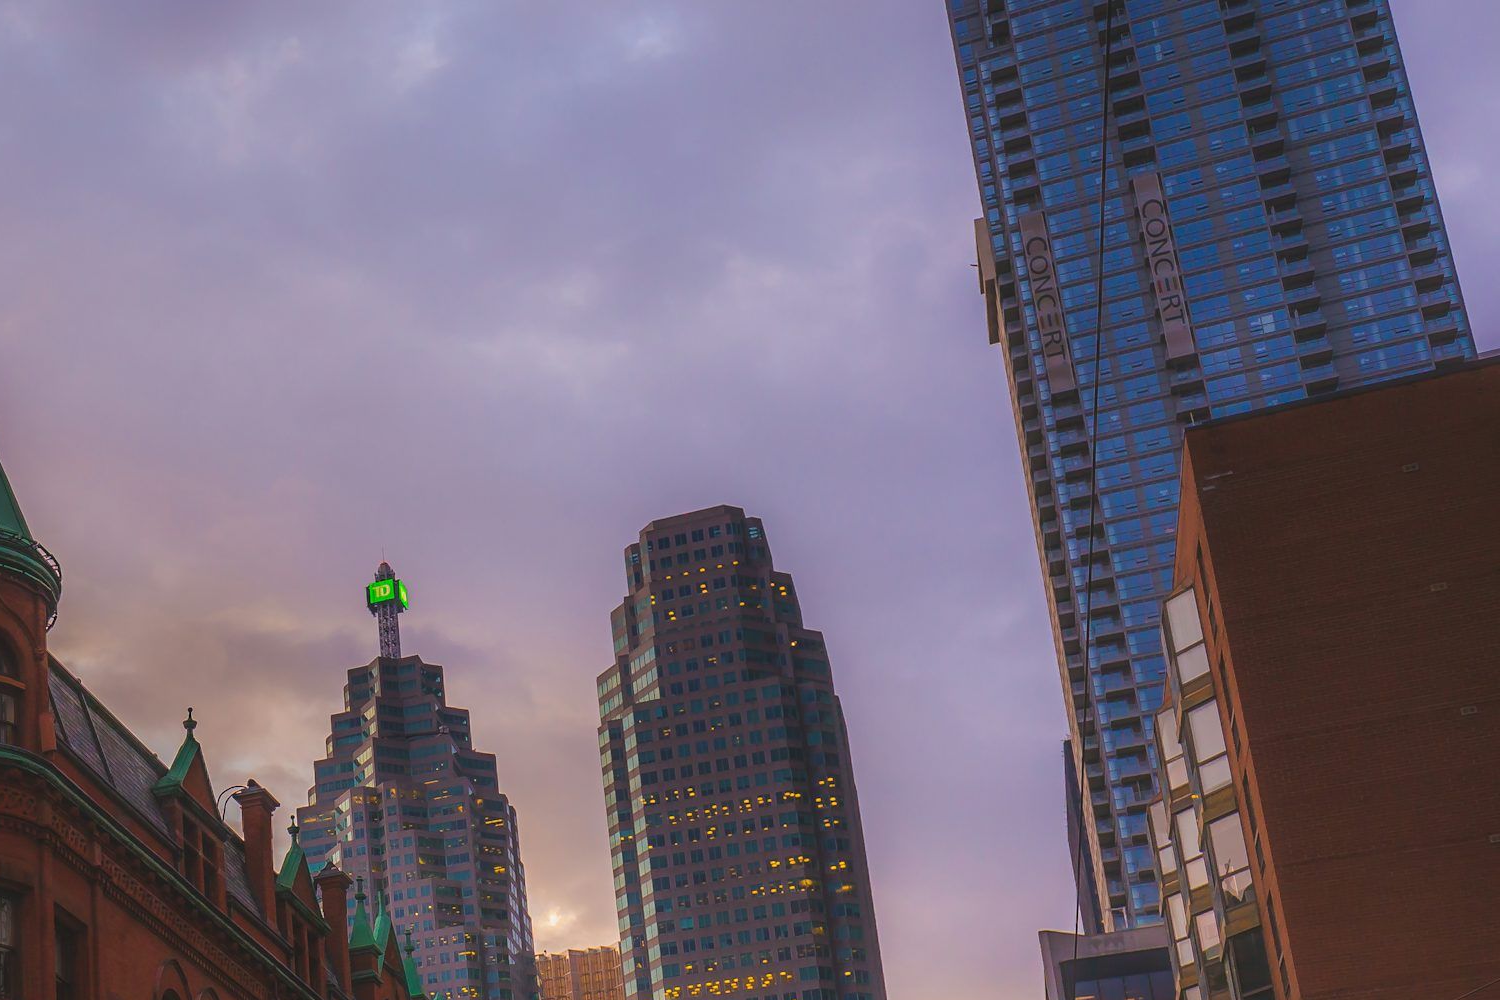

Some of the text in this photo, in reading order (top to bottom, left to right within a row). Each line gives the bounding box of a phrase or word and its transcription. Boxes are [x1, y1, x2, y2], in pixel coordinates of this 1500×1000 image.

[1026, 236, 1067, 361] CONCERT
[1141, 199, 1187, 326] CONCERT
[372, 584, 390, 598] TD
